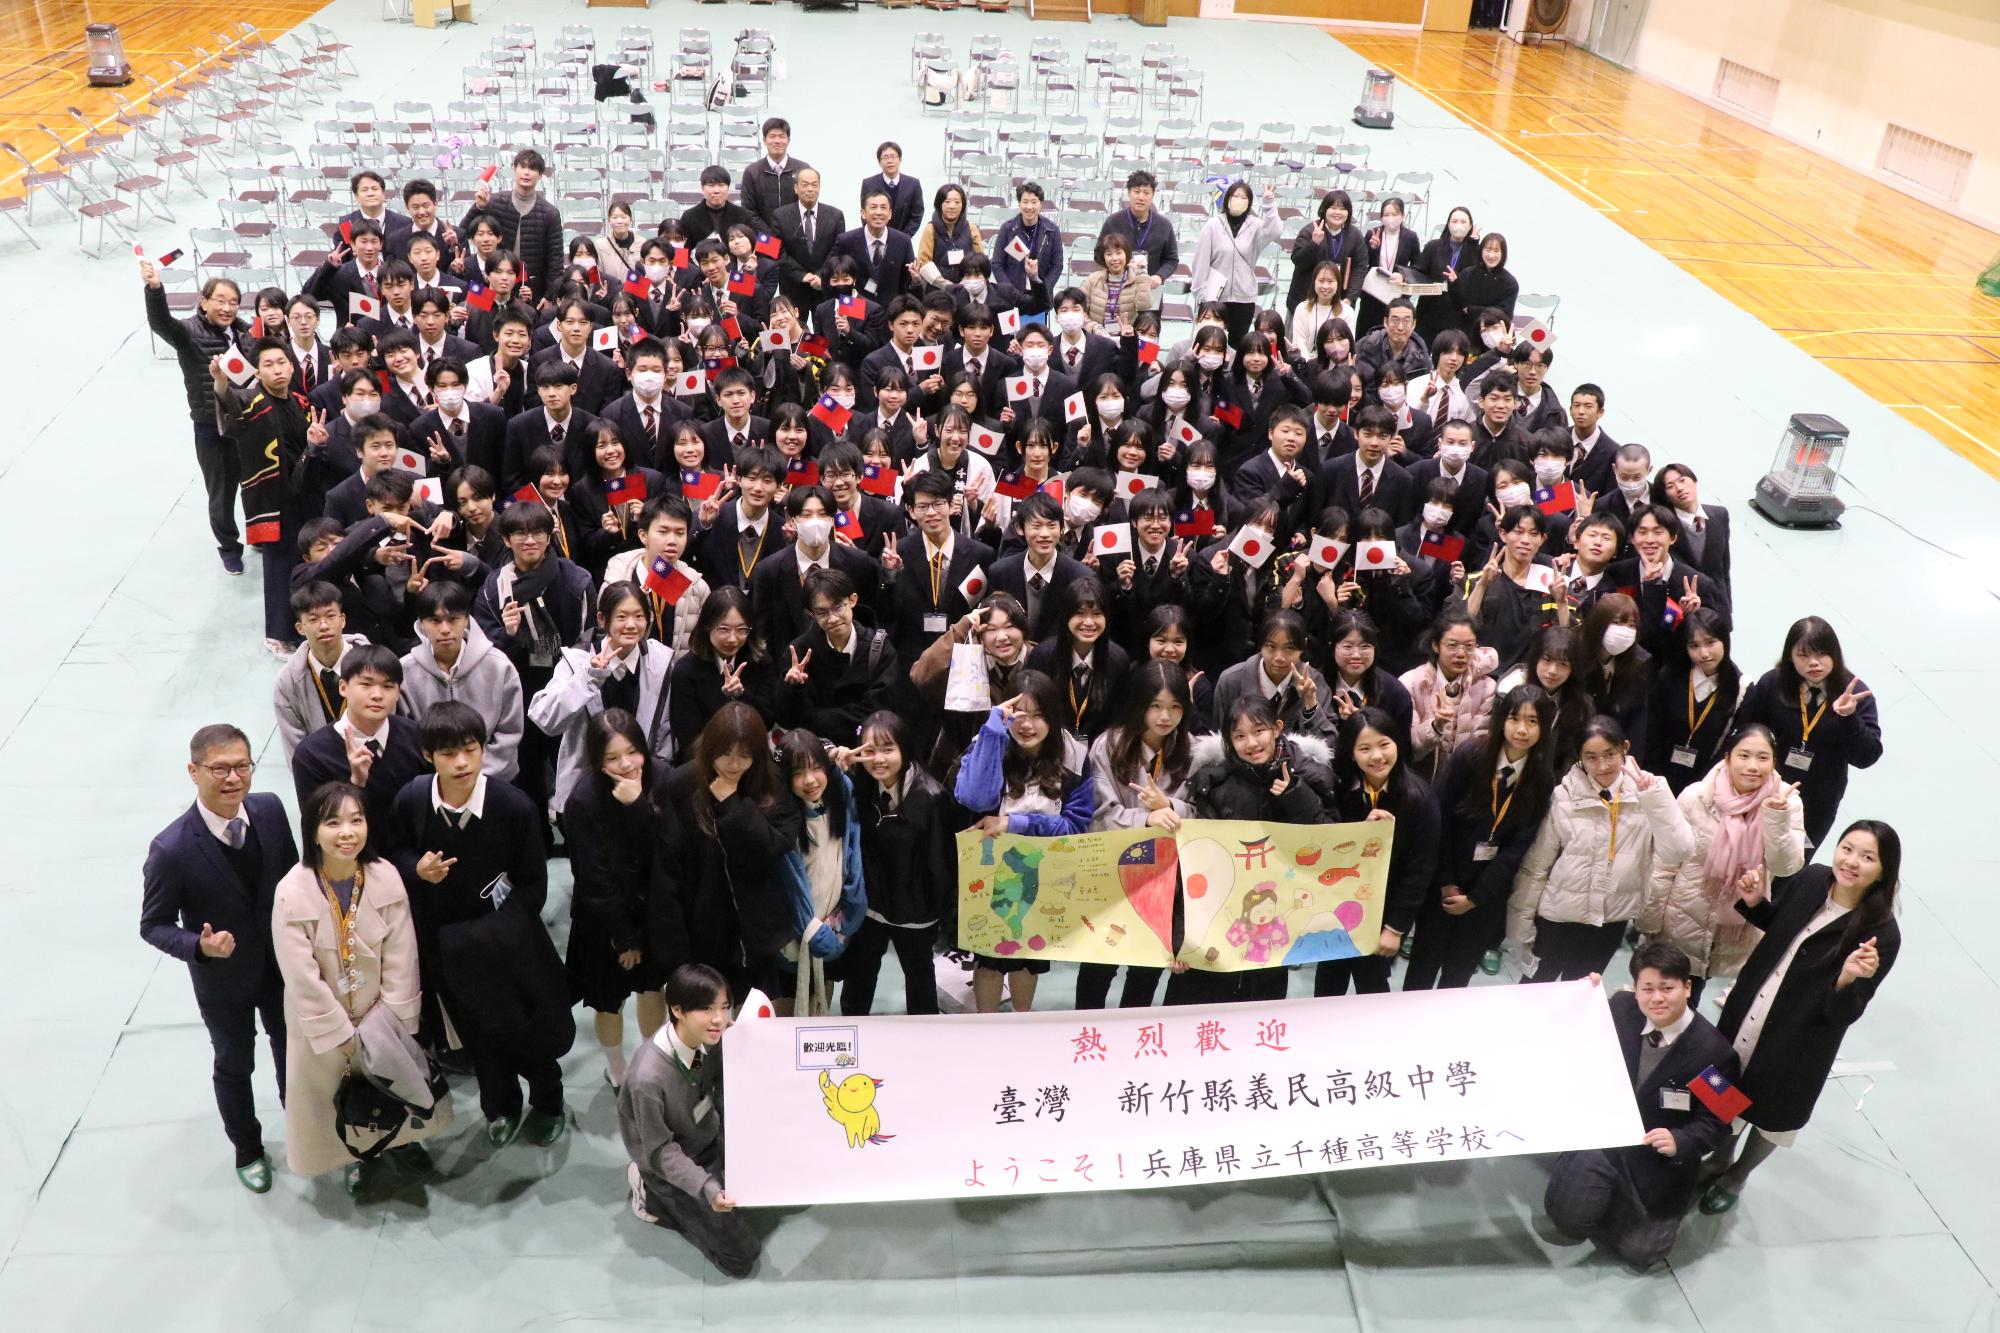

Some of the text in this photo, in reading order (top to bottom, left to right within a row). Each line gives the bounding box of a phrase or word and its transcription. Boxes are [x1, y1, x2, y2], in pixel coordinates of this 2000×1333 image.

[1071, 1019, 1291, 1063] 熱烈歡迎
[993, 1061, 1477, 1124] 臺灣 新竹縣義民高級中學
